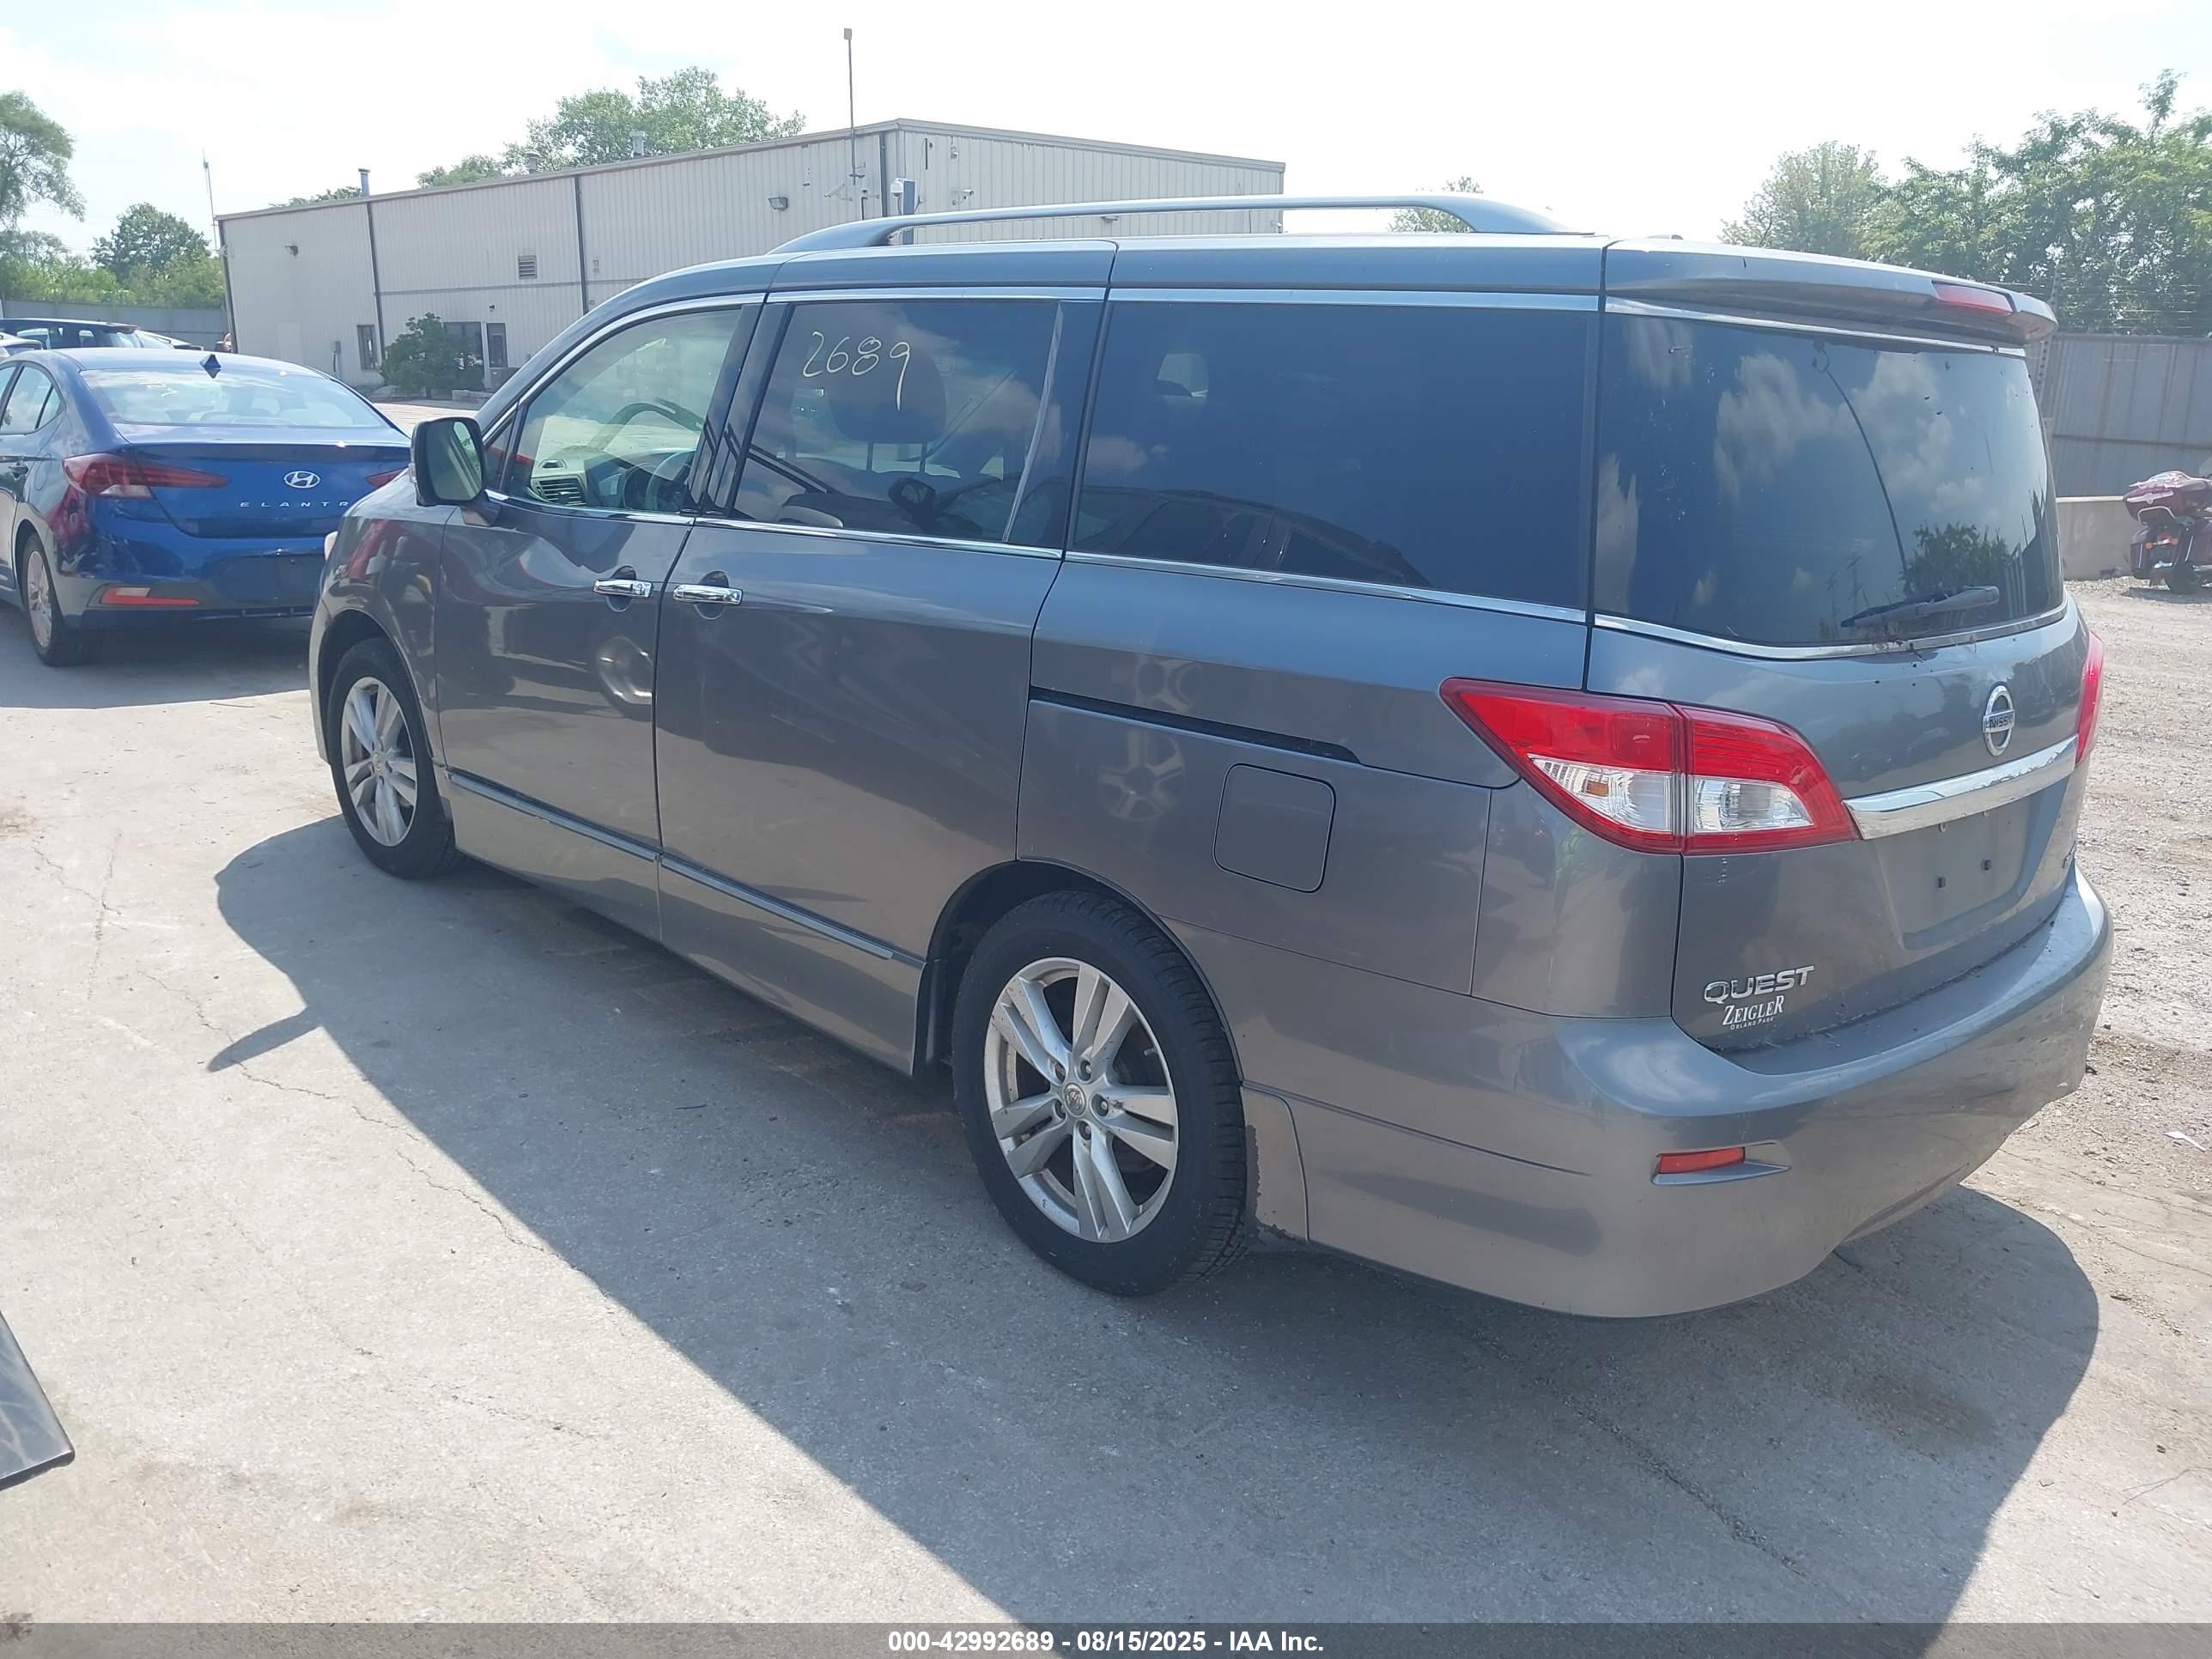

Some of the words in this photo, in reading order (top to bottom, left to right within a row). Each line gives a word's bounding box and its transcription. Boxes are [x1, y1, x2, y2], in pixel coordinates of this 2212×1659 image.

[803, 331, 910, 411] 2689
[1704, 965, 1814, 1004] QUEST
[1722, 994, 1784, 1025] ZEIGLER
